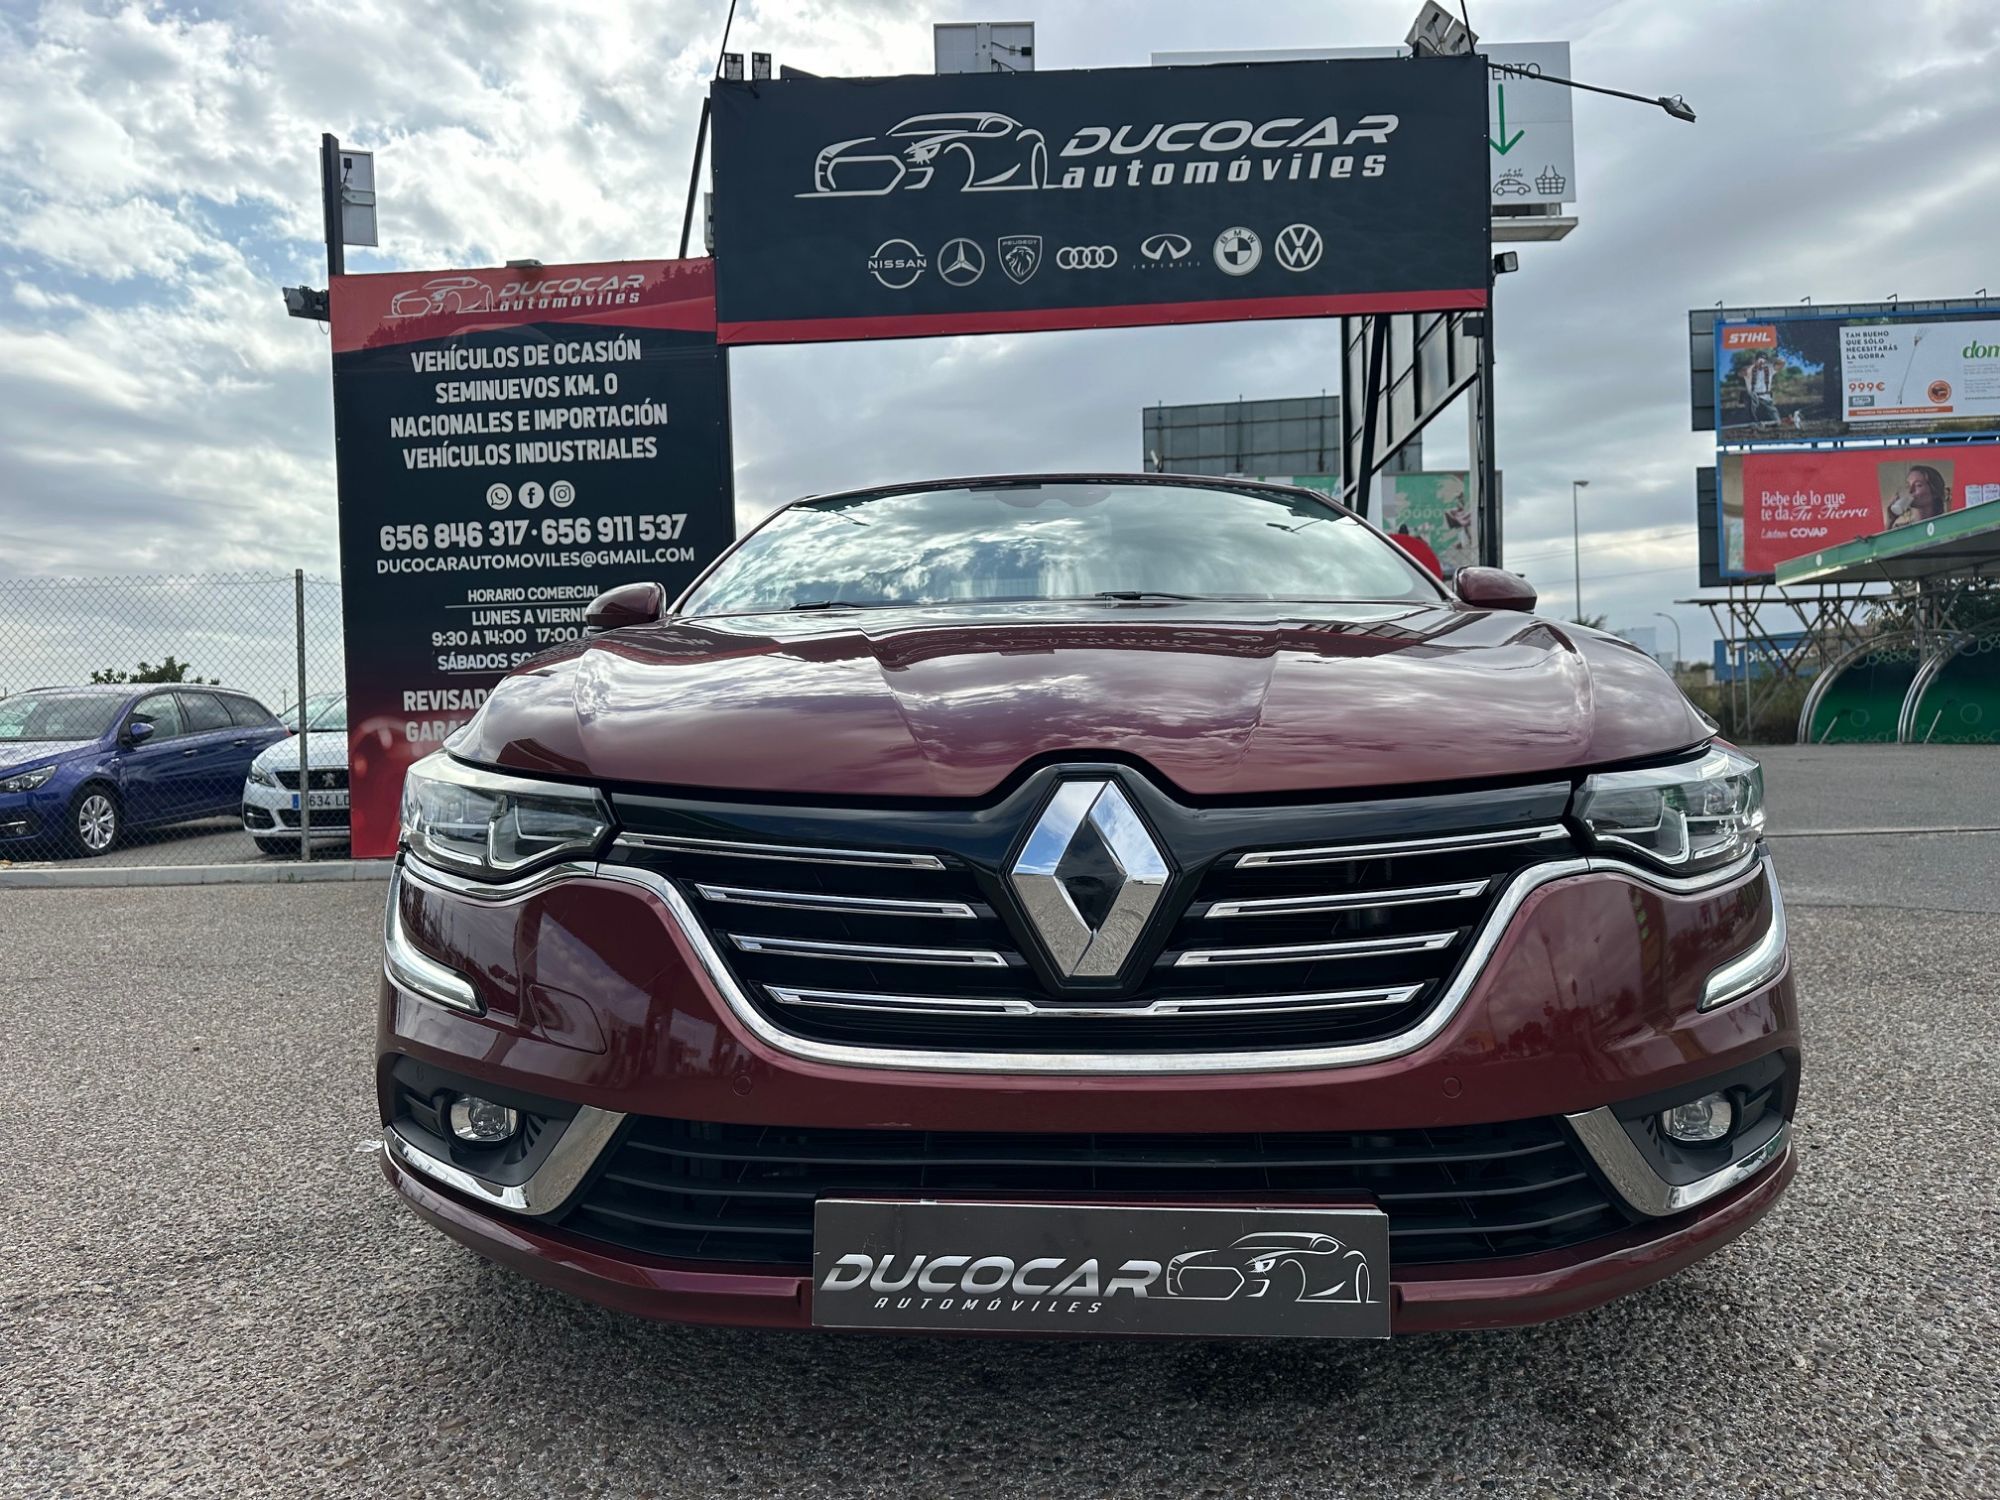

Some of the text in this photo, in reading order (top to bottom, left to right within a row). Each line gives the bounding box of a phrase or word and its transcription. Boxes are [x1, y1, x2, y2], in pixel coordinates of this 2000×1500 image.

[1491, 62, 1541, 80] ERTO
[1059, 114, 1400, 157] DUCOCAR
[1062, 152, 1387, 189] automóviles
[1219, 230, 1256, 244] BMW
[868, 259, 927, 269] NISSAN
[499, 274, 645, 297] DUCOCAR
[1728, 332, 1771, 344] STIHL
[410, 334, 641, 373] VEHÍCULOS DE OCASIÓN
[1846, 344, 1898, 353] NECESITARÁS
[1858, 352, 1886, 360] GORRA
[435, 376, 560, 404] SEMINUEVOS
[564, 375, 600, 398] KM.
[1848, 381, 1886, 393] 999€
[390, 398, 668, 439] NACIONALES E IMPORTACIÓN
[403, 436, 657, 470] VEHÍCULOS INDUSTRIALES
[1761, 489, 1846, 507] Bebe de lo que
[1761, 508, 1772, 521] te
[1818, 504, 1869, 519] Tierra
[380, 525, 428, 551] 656
[434, 522, 483, 549] 846
[541, 518, 592, 545] 656
[597, 516, 634, 542] 911
[639, 513, 688, 541] 537
[1789, 527, 1828, 538] COVAP
[376, 547, 695, 574] DUCOCARAUTOMOVILES@GMAIL.COM
[468, 589, 525, 602] HORARIO
[472, 607, 588, 626] LUNES A VIERN
[432, 631, 468, 646] 9:30
[470, 631, 481, 645] A
[483, 629, 527, 645] 14:00
[536, 627, 578, 643] 17:00
[437, 651, 508, 671] SÁBADOS
[403, 689, 495, 711] REVISAD
[405, 720, 466, 742] GARA
[309, 795, 331, 807] 634
[820, 1253, 1165, 1299] DUCOCAR
[875, 1296, 1103, 1314] AUTOMÓVILES
